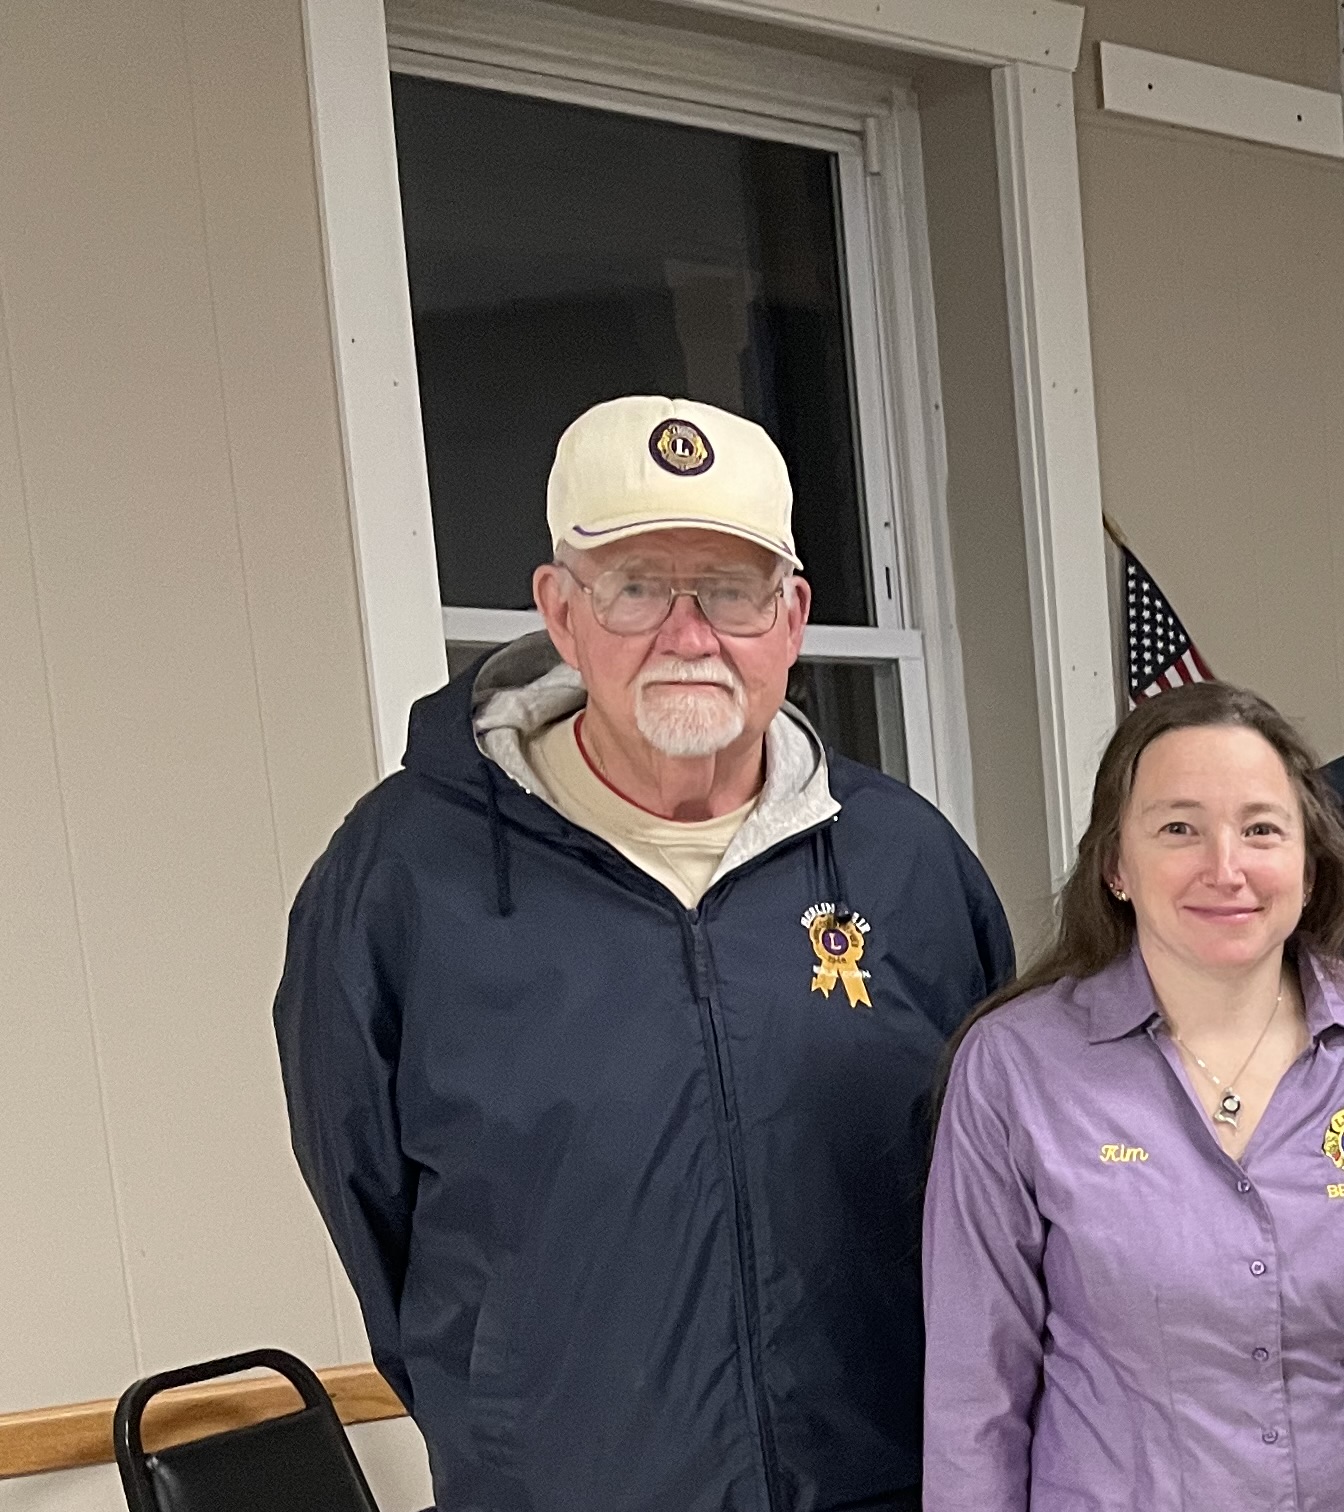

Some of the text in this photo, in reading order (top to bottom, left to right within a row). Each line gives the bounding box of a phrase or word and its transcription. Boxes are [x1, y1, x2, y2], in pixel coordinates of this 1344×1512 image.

[676, 438, 689, 457] L
[800, 902, 835, 929] BERLIN
[828, 932, 842, 950] L
[1100, 1143, 1149, 1163] Kim
